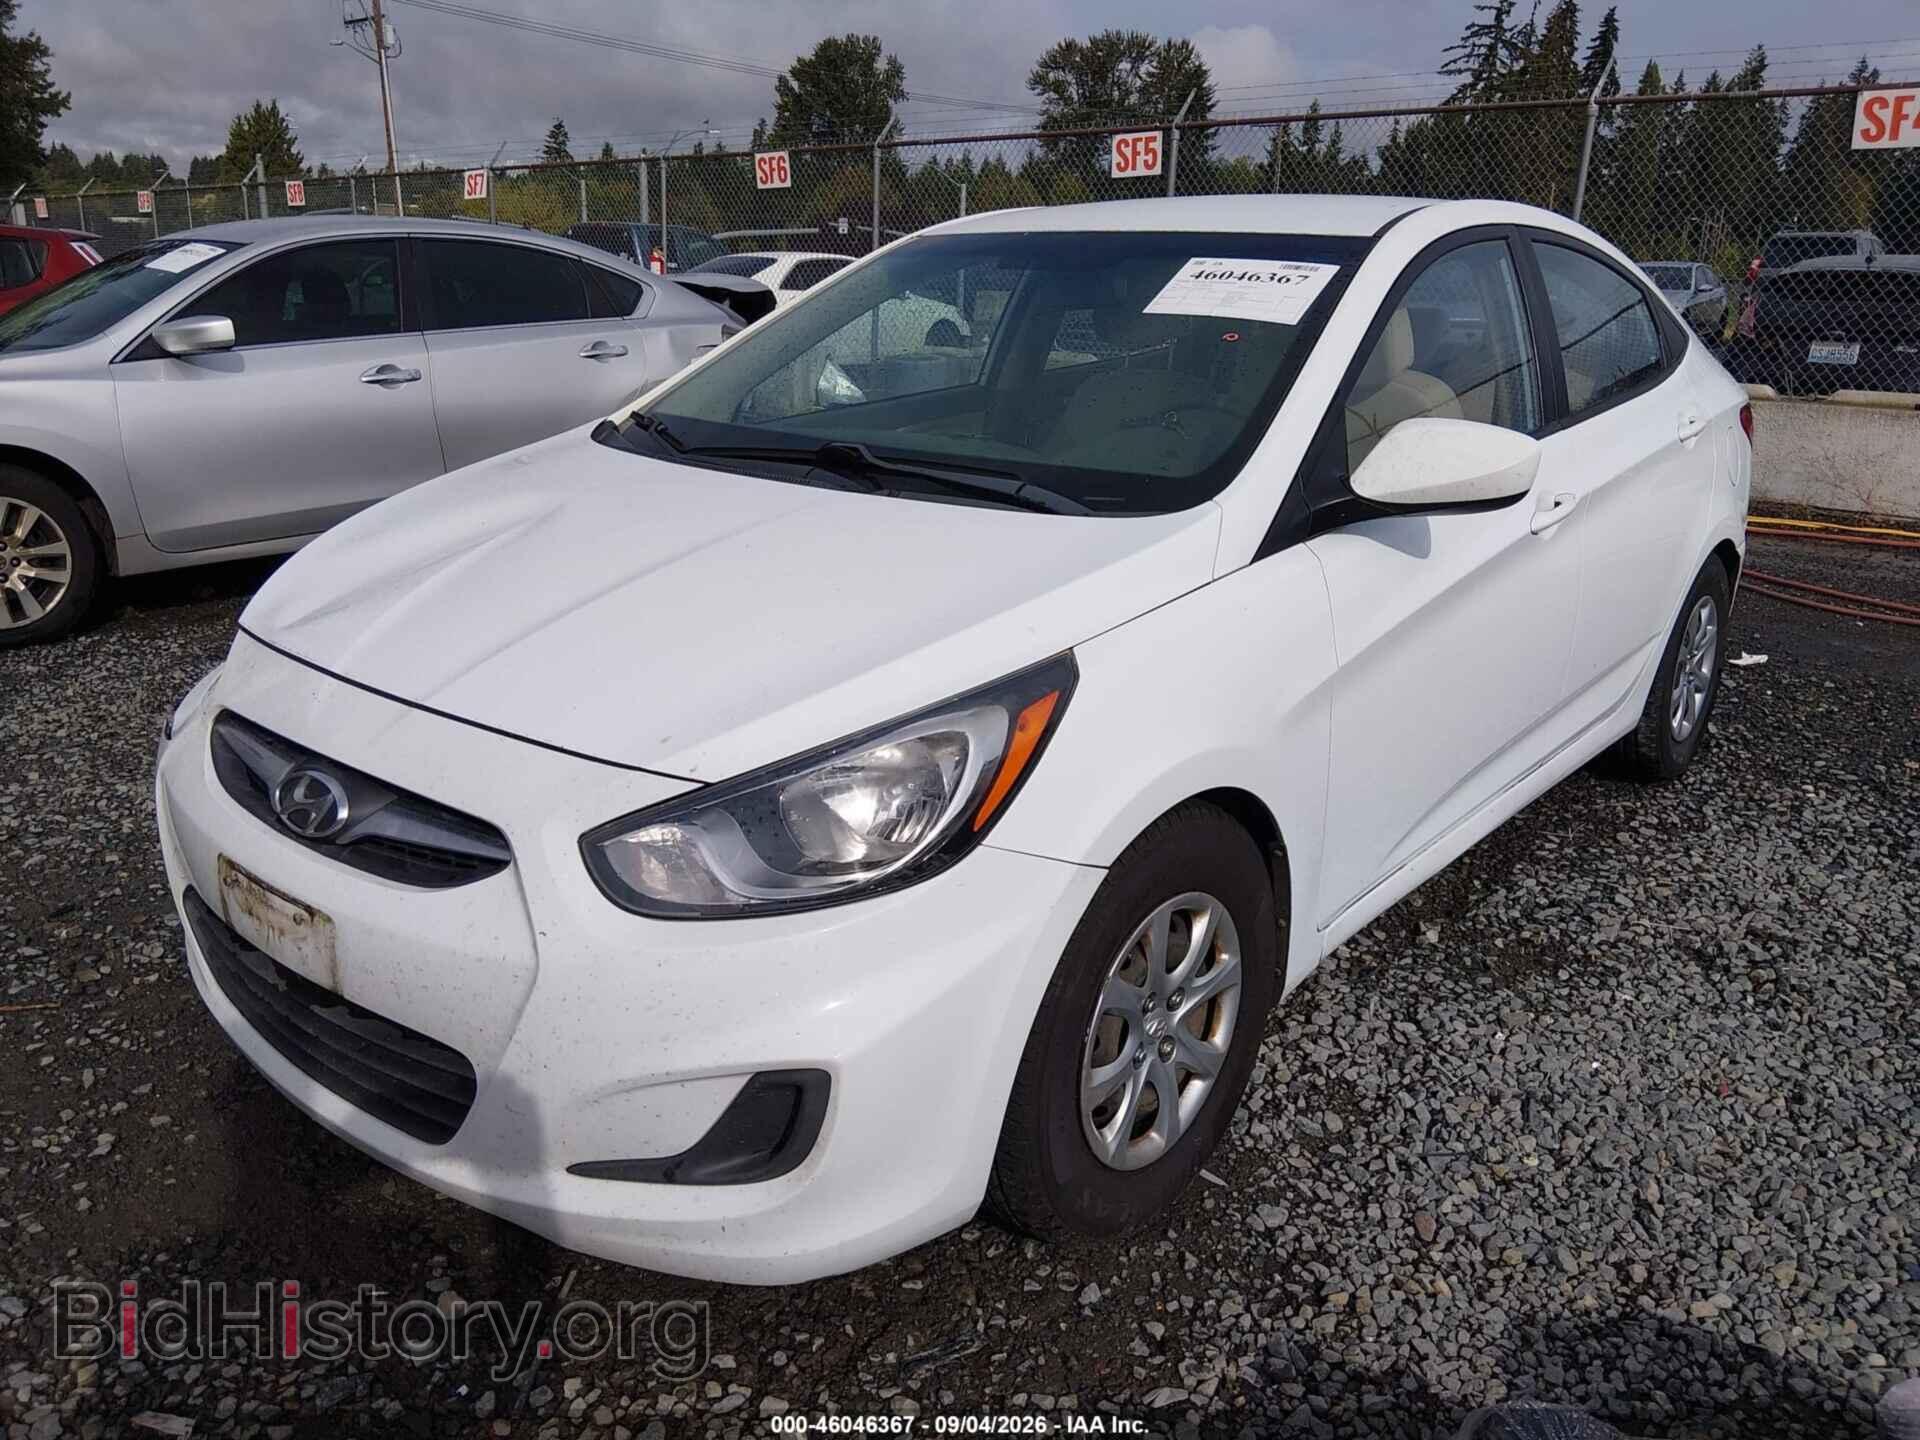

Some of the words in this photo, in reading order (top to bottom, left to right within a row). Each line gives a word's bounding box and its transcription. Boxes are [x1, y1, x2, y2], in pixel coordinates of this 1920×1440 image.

[1116, 136, 1157, 172] SF5
[758, 156, 787, 185] SF6
[467, 173, 484, 196] SF7
[1190, 270, 1310, 285] 46046367
